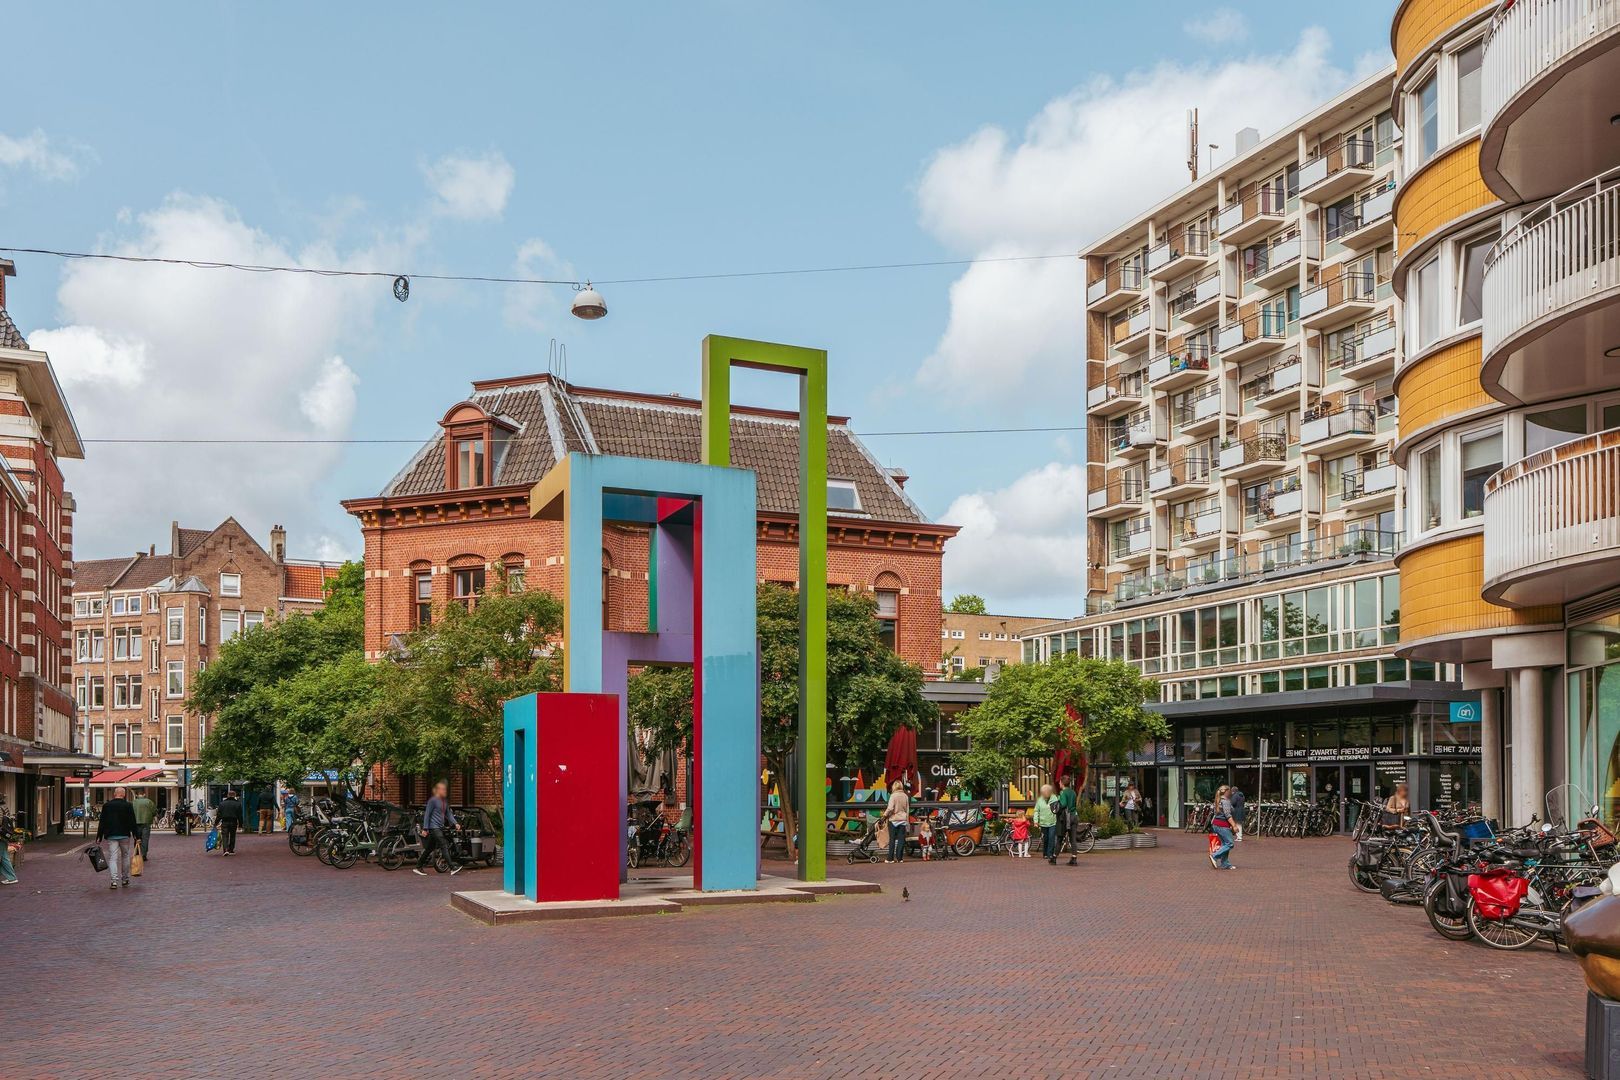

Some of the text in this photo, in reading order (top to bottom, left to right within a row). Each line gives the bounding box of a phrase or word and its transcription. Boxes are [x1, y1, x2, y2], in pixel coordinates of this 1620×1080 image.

[1310, 748, 1338, 756] ZWARTE
[1340, 747, 1369, 755] FIETSEN
[1443, 745, 1455, 753] HET
[931, 765, 957, 776] Club
